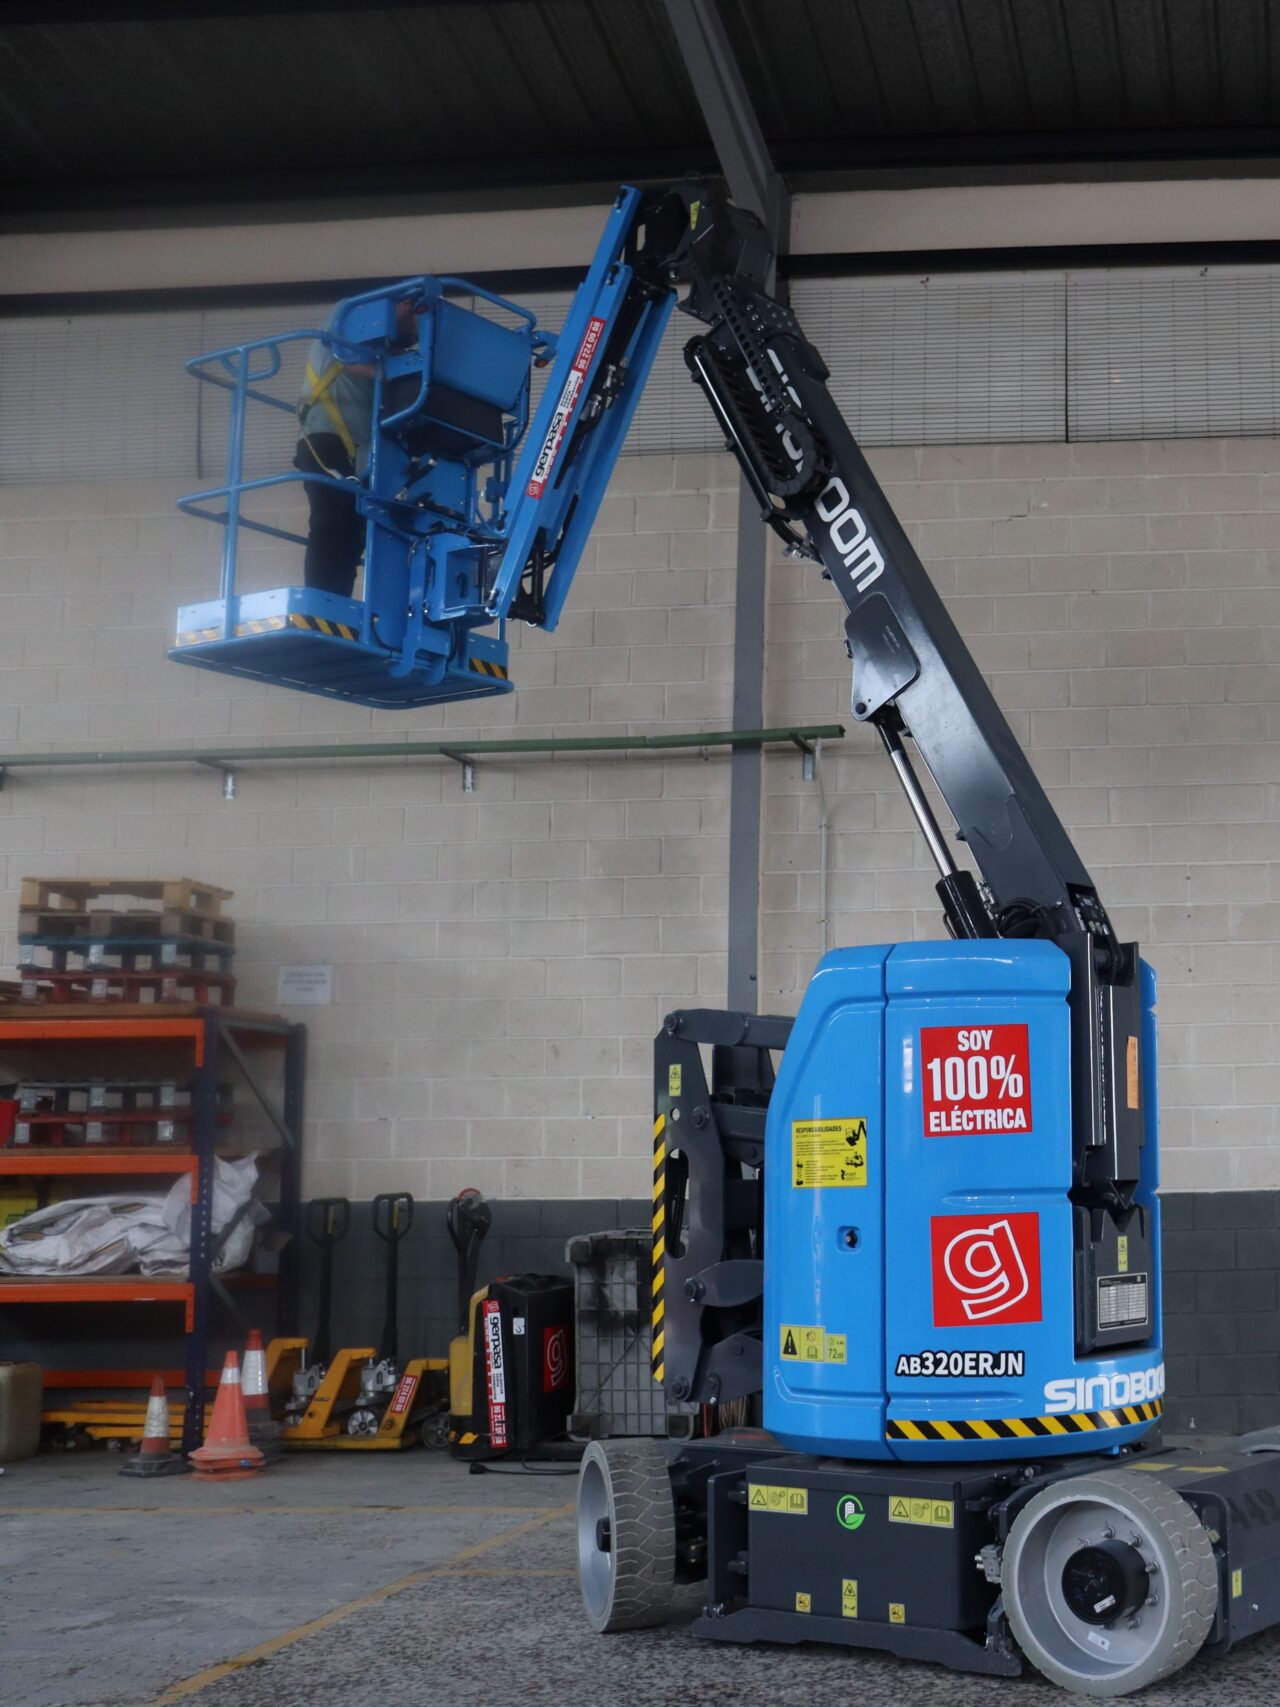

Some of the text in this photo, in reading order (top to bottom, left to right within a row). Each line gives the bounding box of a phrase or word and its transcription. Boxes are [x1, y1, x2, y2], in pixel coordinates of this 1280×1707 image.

[534, 411, 564, 478] gerpasa
[957, 1030, 993, 1051] SOY
[927, 1054, 1024, 1101] 100%
[929, 1105, 1027, 1132] ELÉCTRICA
[489, 1316, 502, 1369] gerpasa
[896, 1352, 1024, 1376] AB320ERJN
[1043, 1362, 1165, 1413] SINOBOO
